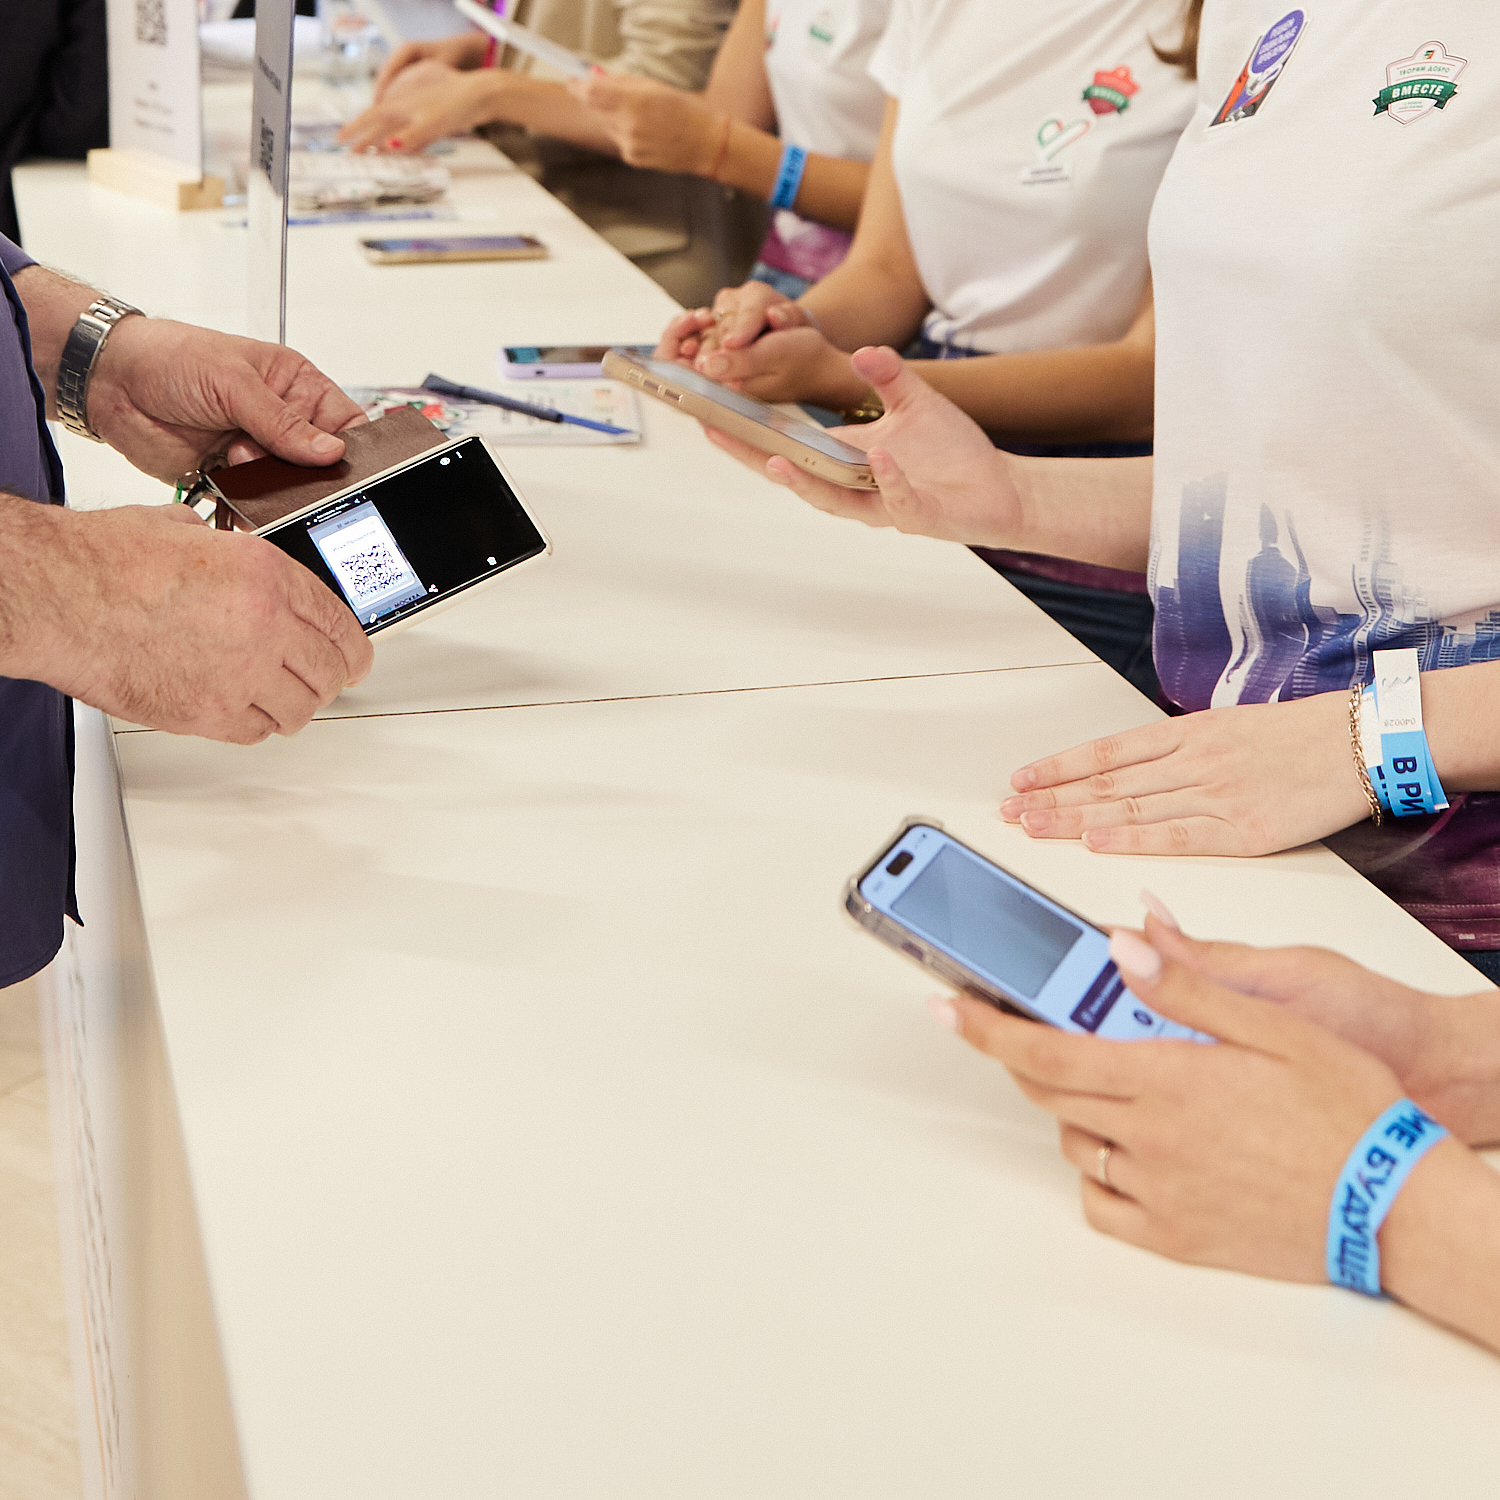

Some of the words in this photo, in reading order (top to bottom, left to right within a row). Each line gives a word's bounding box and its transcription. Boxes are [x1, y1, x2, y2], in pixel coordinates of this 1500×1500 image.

[1391, 83, 1445, 99] ВМЕСТЕ
[1392, 755, 1418, 775] В
[1396, 781, 1429, 814] РИ
